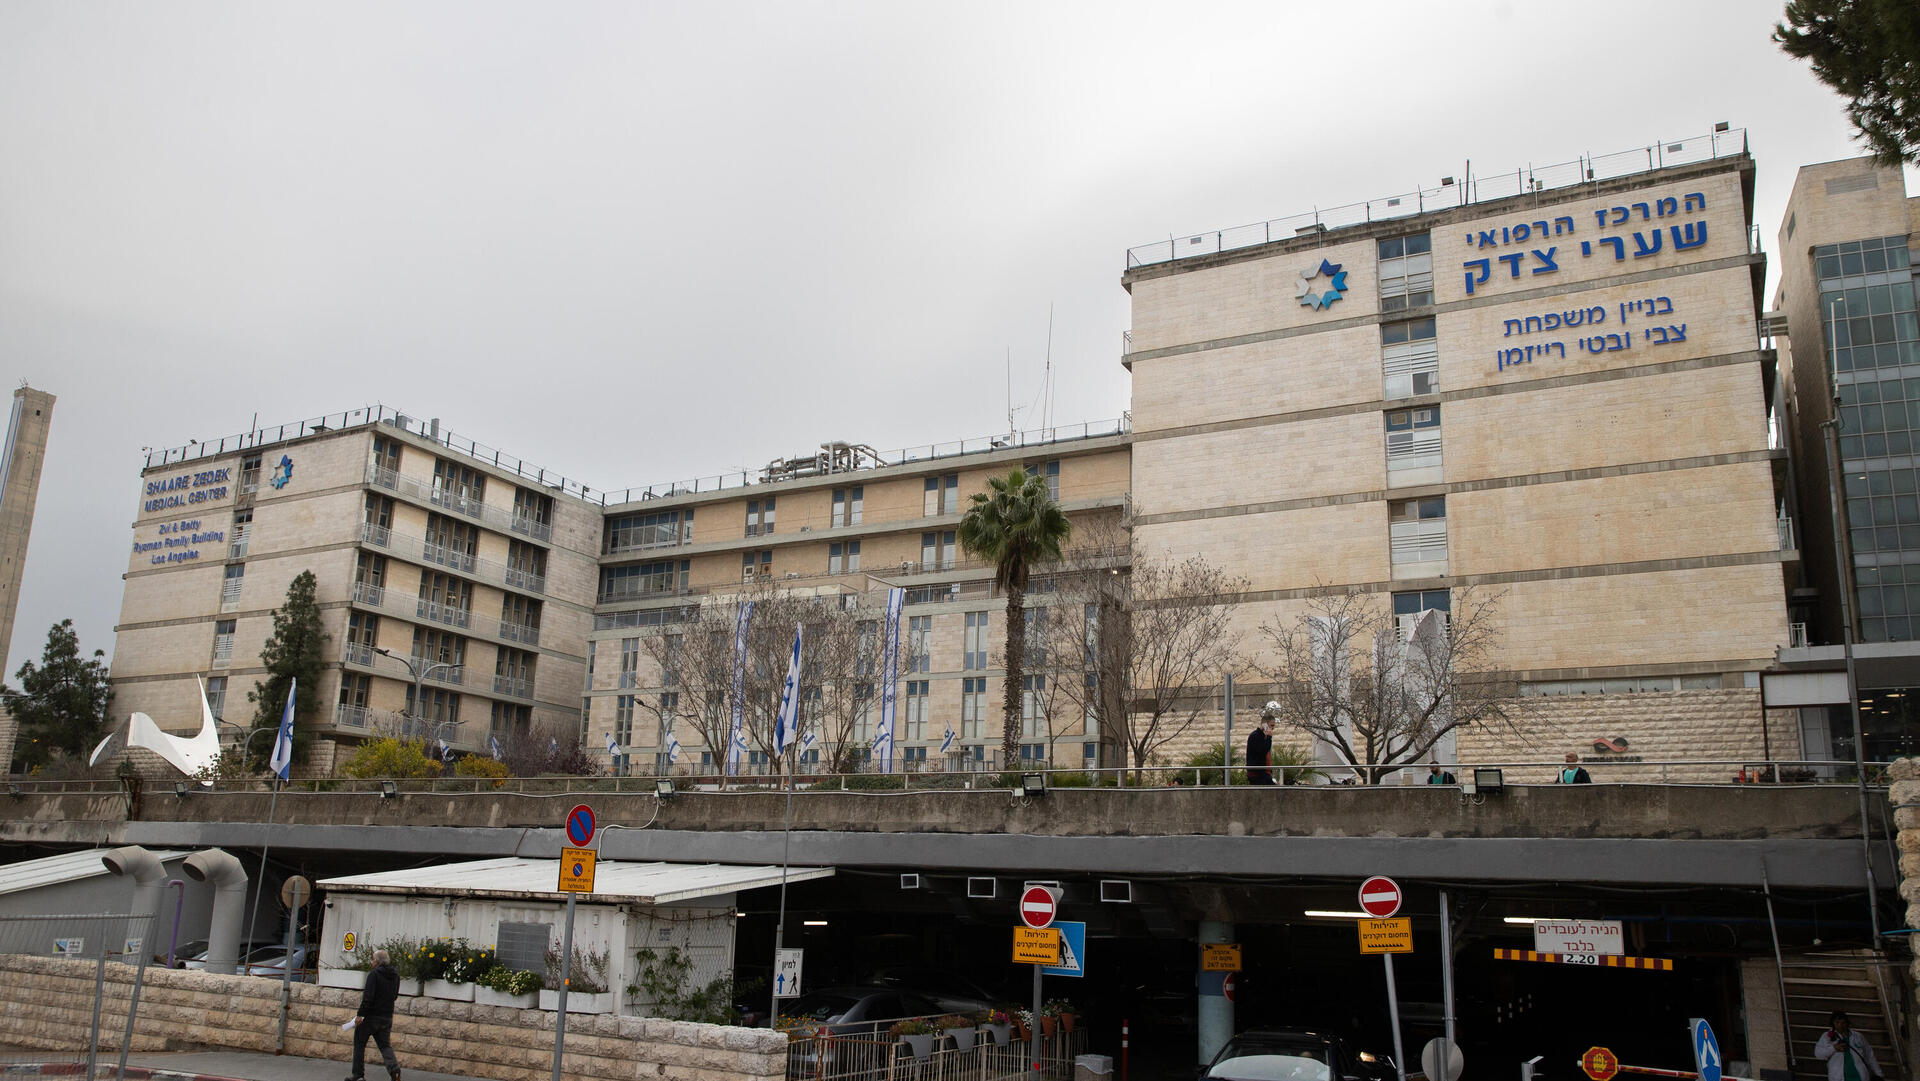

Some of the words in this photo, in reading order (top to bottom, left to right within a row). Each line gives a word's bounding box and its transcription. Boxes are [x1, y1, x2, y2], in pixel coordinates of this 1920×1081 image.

[1594, 192, 1706, 228] המרכז
[1465, 216, 1575, 249] הרפואי
[1580, 220, 1708, 262] שערי
[1463, 246, 1559, 295] צדק
[1503, 305, 1606, 337] משפחת
[1619, 296, 1674, 325] בניין
[1579, 331, 1632, 354] ובטי
[1645, 323, 1687, 345] צבי
[1497, 341, 1566, 372] רייזמן
[146, 475, 190, 496] SHAARE
[192, 467, 231, 487] ZEDEK
[144, 494, 185, 513] MEDICAL
[188, 486, 228, 504] CENTER
[158, 524, 170, 535] Zvi
[172, 522, 178, 533] &
[180, 520, 202, 533] Betty
[164, 535, 189, 549] Family
[191, 530, 224, 545] Building
[151, 554, 165, 565] Los
[167, 550, 199, 564] Angeles
[1538, 923, 1586, 935] לעובדים
[1590, 925, 1619, 935] חניה
[1563, 939, 1595, 951] בלבד
[782, 959, 796, 971] למיון
[1566, 953, 1595, 965] 2.20
